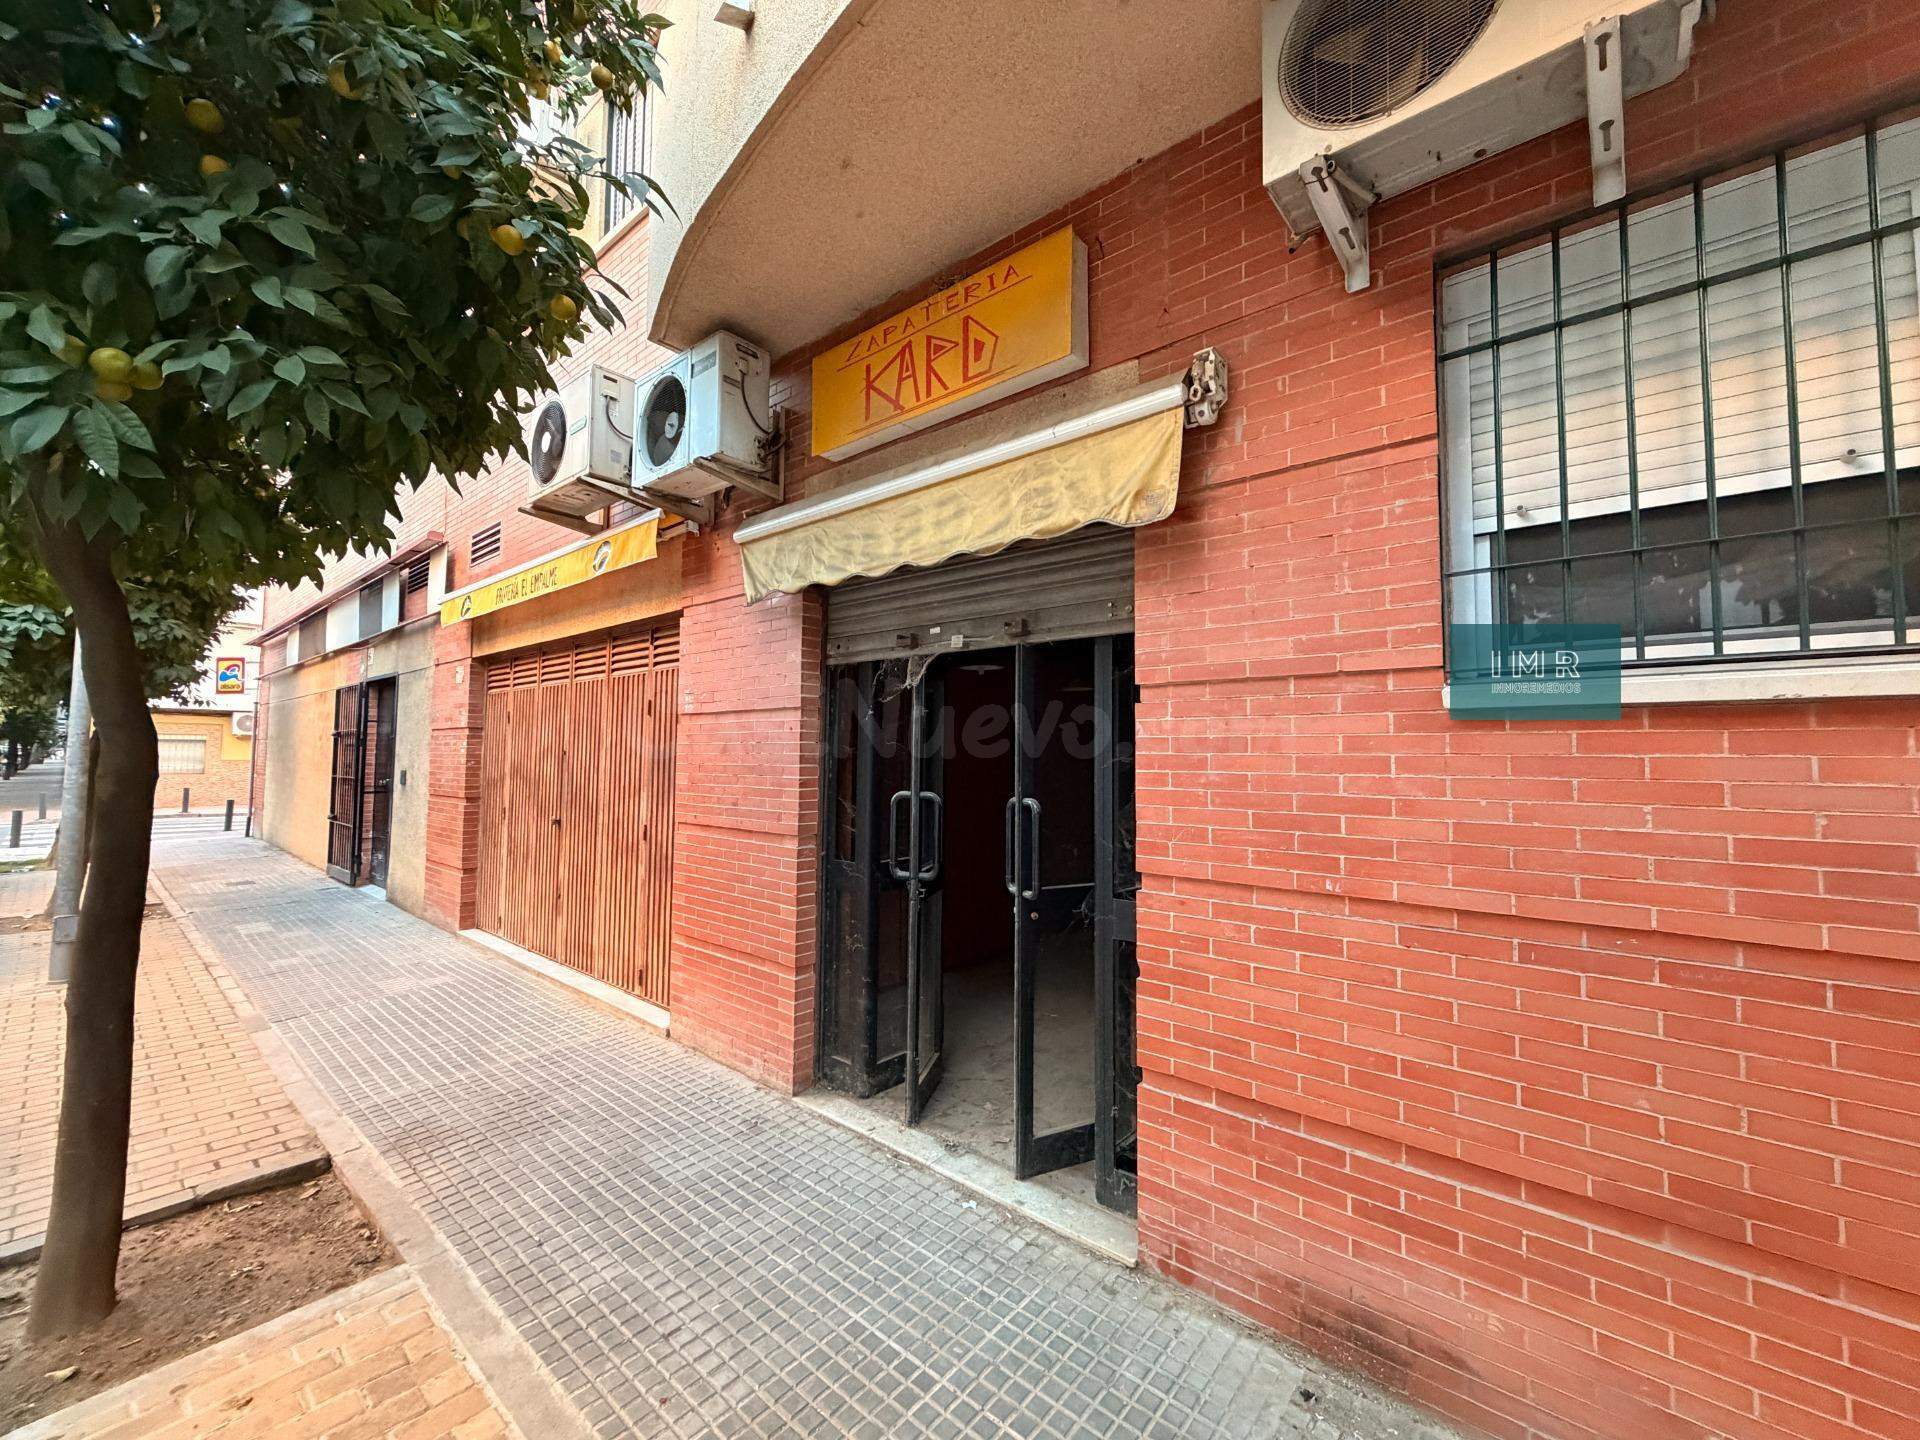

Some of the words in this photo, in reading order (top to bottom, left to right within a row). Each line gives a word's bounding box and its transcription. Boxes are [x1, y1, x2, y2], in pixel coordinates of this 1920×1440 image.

[846, 264, 1020, 363] ZAPATERIA
[863, 315, 1000, 422] KARD
[521, 578, 528, 597] EL
[530, 566, 558, 594] EMPALME
